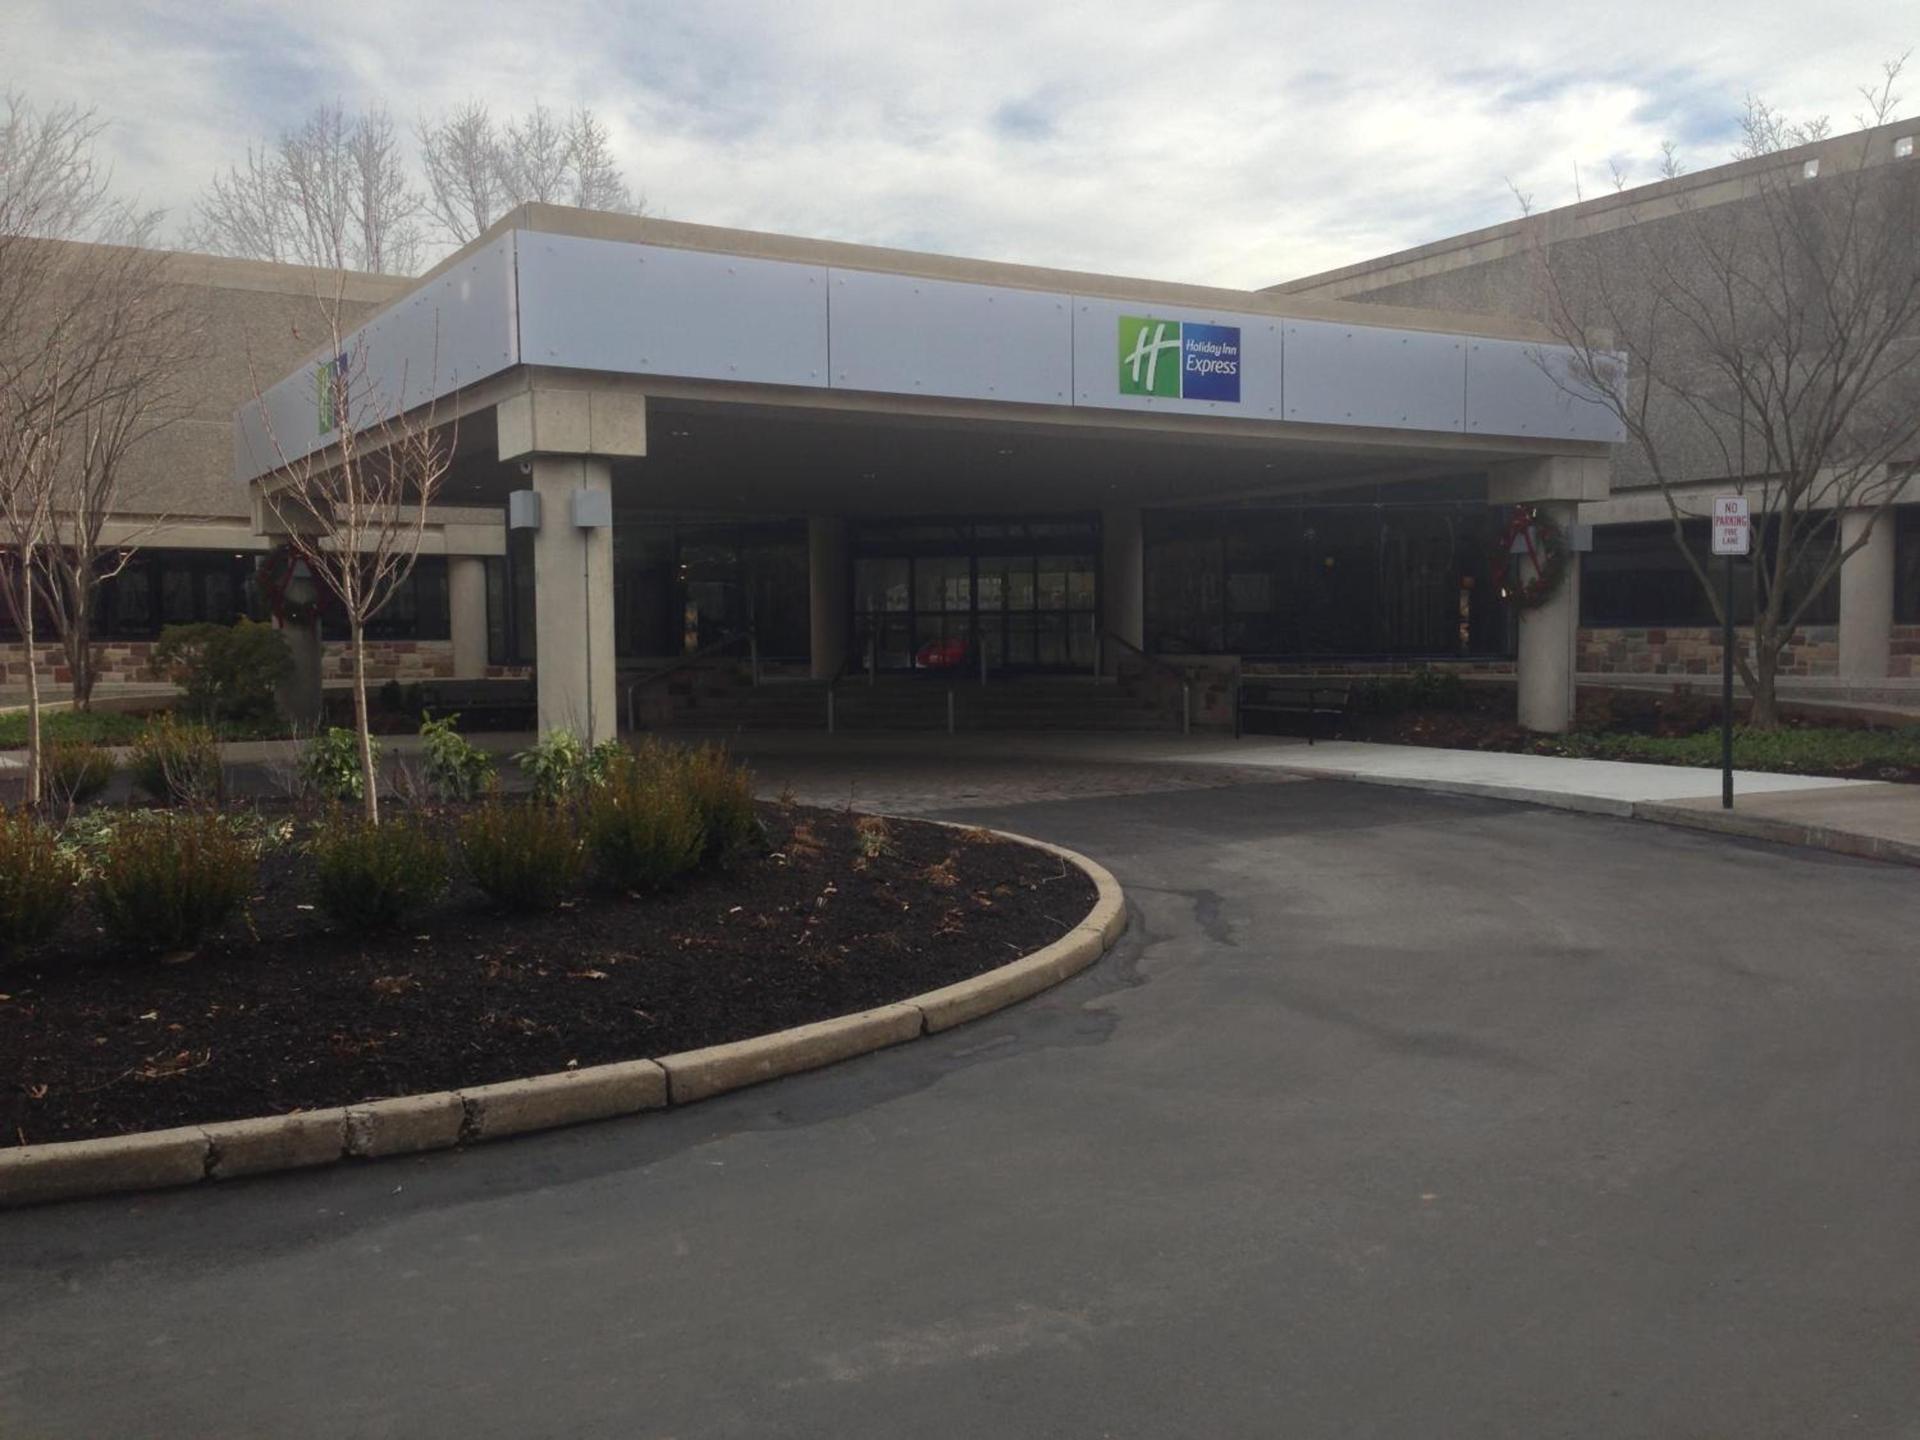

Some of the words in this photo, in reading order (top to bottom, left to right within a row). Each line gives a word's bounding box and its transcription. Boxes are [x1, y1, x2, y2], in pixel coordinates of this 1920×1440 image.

[1186, 339, 1221, 356] Holiday
[1222, 342, 1237, 355] Inn
[1186, 354, 1237, 376] Express
[1725, 502, 1737, 513] NO
[1716, 515, 1747, 527] PARKING
